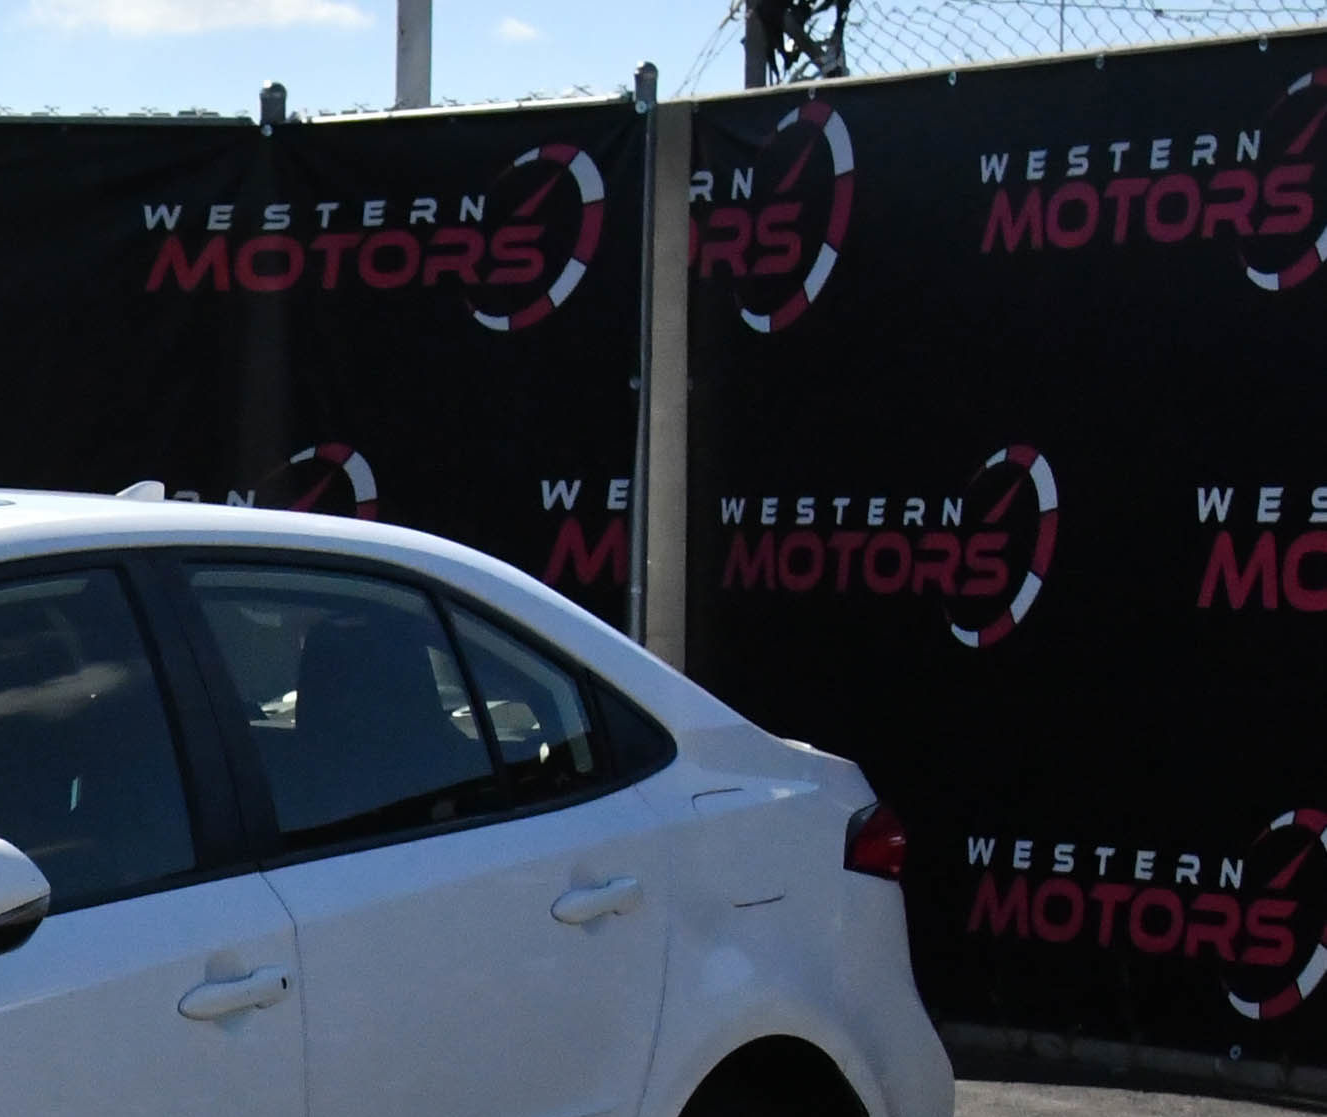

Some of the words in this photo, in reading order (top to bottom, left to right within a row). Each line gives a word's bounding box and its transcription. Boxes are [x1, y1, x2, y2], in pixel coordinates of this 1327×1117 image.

[980, 129, 1260, 183] WESTERN
[144, 195, 485, 230] WESTERN
[981, 164, 1315, 255] MOTORS
[146, 225, 544, 292] MOTORS
[720, 497, 963, 526] WESTERN
[722, 531, 1009, 597] MOTORS
[968, 836, 1244, 889] WESTERN
[967, 870, 1298, 967] MOTORS
